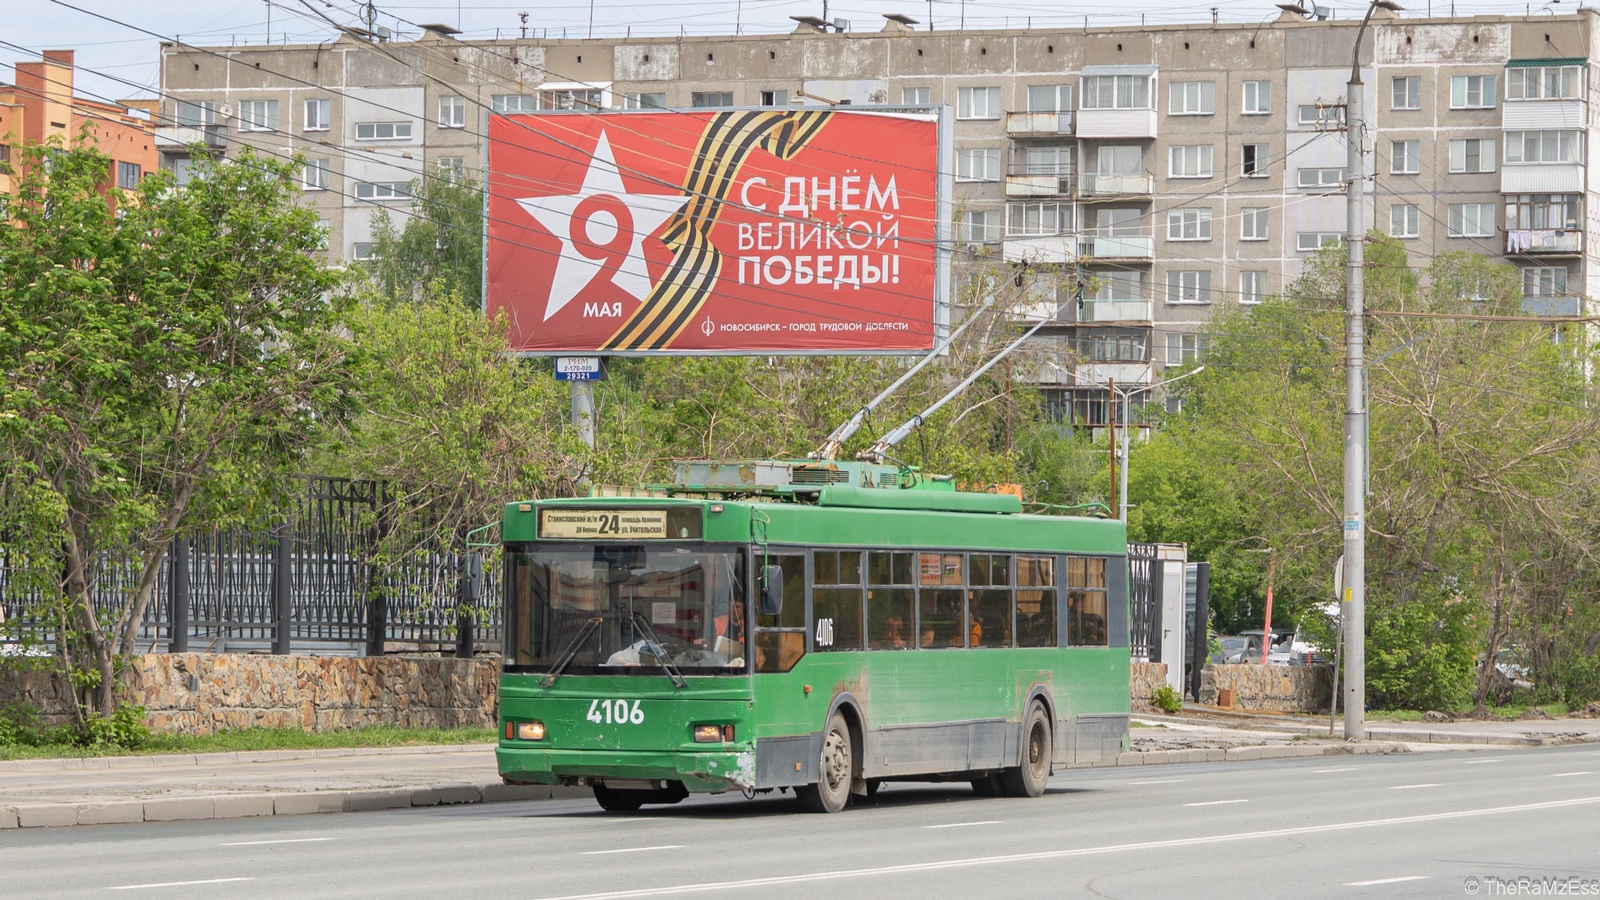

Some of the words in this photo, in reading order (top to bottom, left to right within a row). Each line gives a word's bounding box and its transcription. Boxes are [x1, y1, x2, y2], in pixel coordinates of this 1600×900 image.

[741, 177, 766, 211] С
[779, 169, 899, 218] ДНЁМ
[569, 193, 634, 282] 9
[738, 214, 899, 250] ВЕЛИКОЙ
[738, 255, 899, 290] ПОБЕДЫ!
[583, 302, 622, 317] МАЯ
[720, 323, 780, 332] НОВОСИБИРСК
[789, 323, 816, 332] ГОРОД
[819, 321, 862, 332] ТРУДОВОЙ
[865, 322, 909, 332] ДОБЛЕСТИ
[547, 514, 586, 522] Станиславский
[599, 514, 620, 534] 24
[629, 525, 662, 533] Учительская
[816, 618, 834, 646] 4106
[587, 699, 645, 724] 4106
